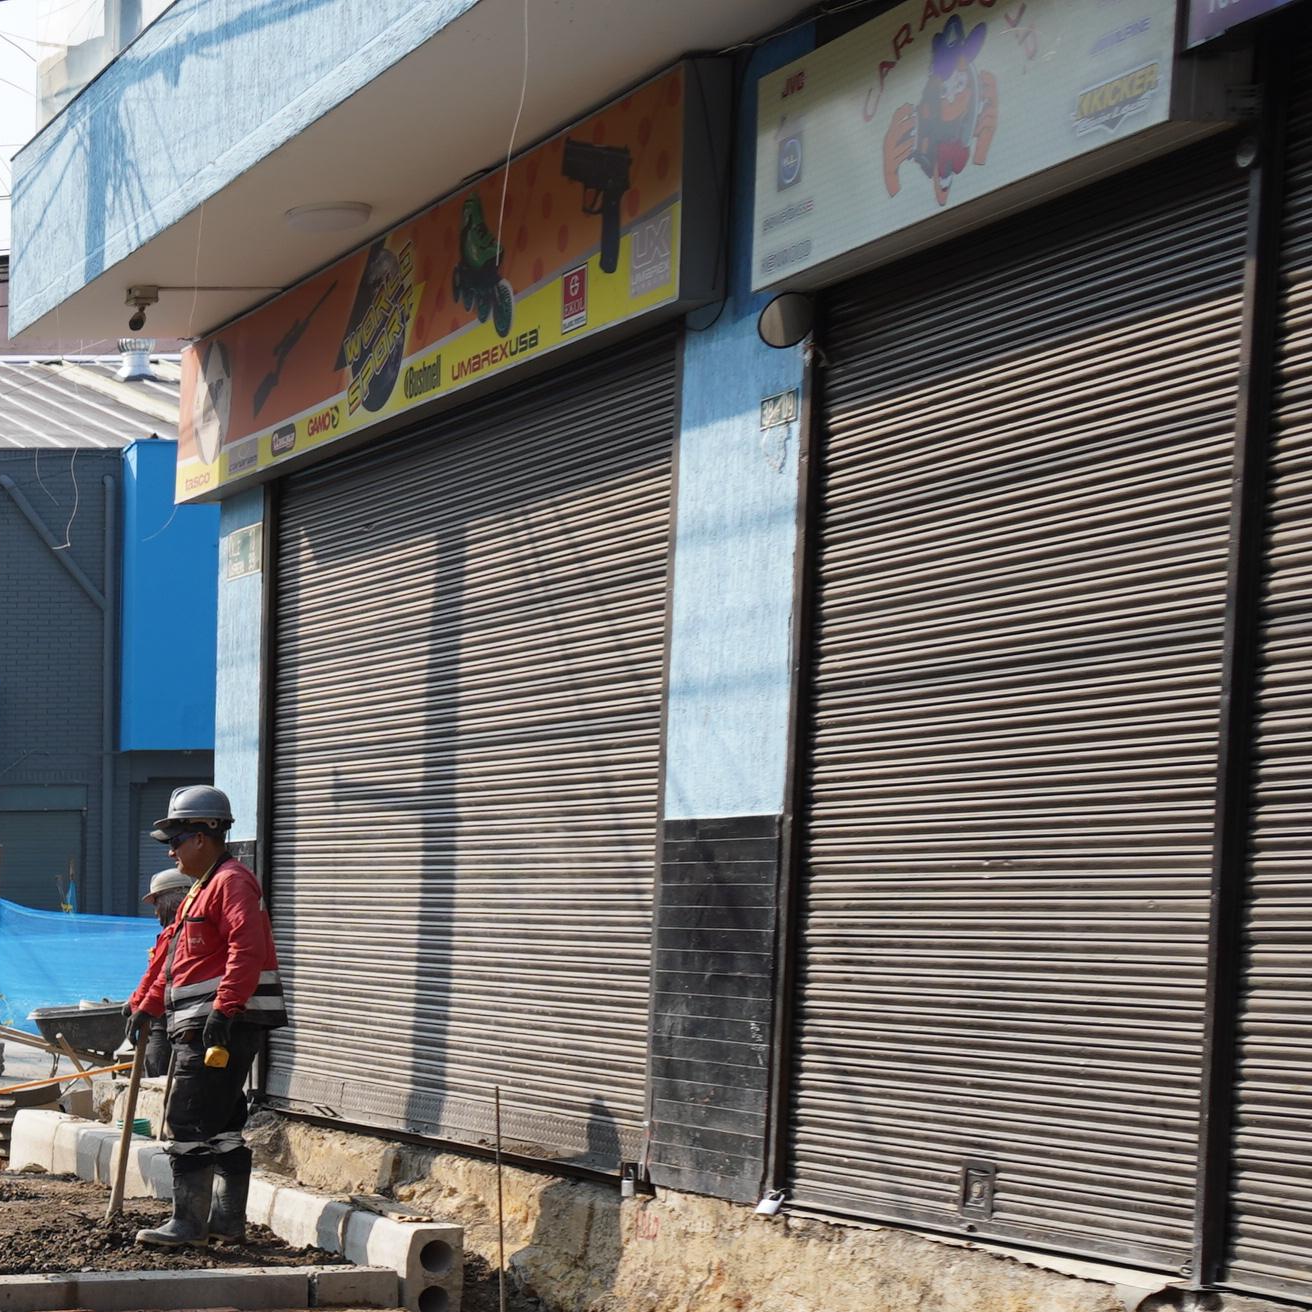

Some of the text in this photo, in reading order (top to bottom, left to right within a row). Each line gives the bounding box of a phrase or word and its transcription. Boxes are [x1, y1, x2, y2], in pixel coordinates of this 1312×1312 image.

[781, 70, 807, 98] JVC
[1081, 62, 1159, 117] KICKER
[407, 354, 442, 399] Bushnell
[307, 411, 331, 438] GAMO
[185, 472, 211, 491] tasco
